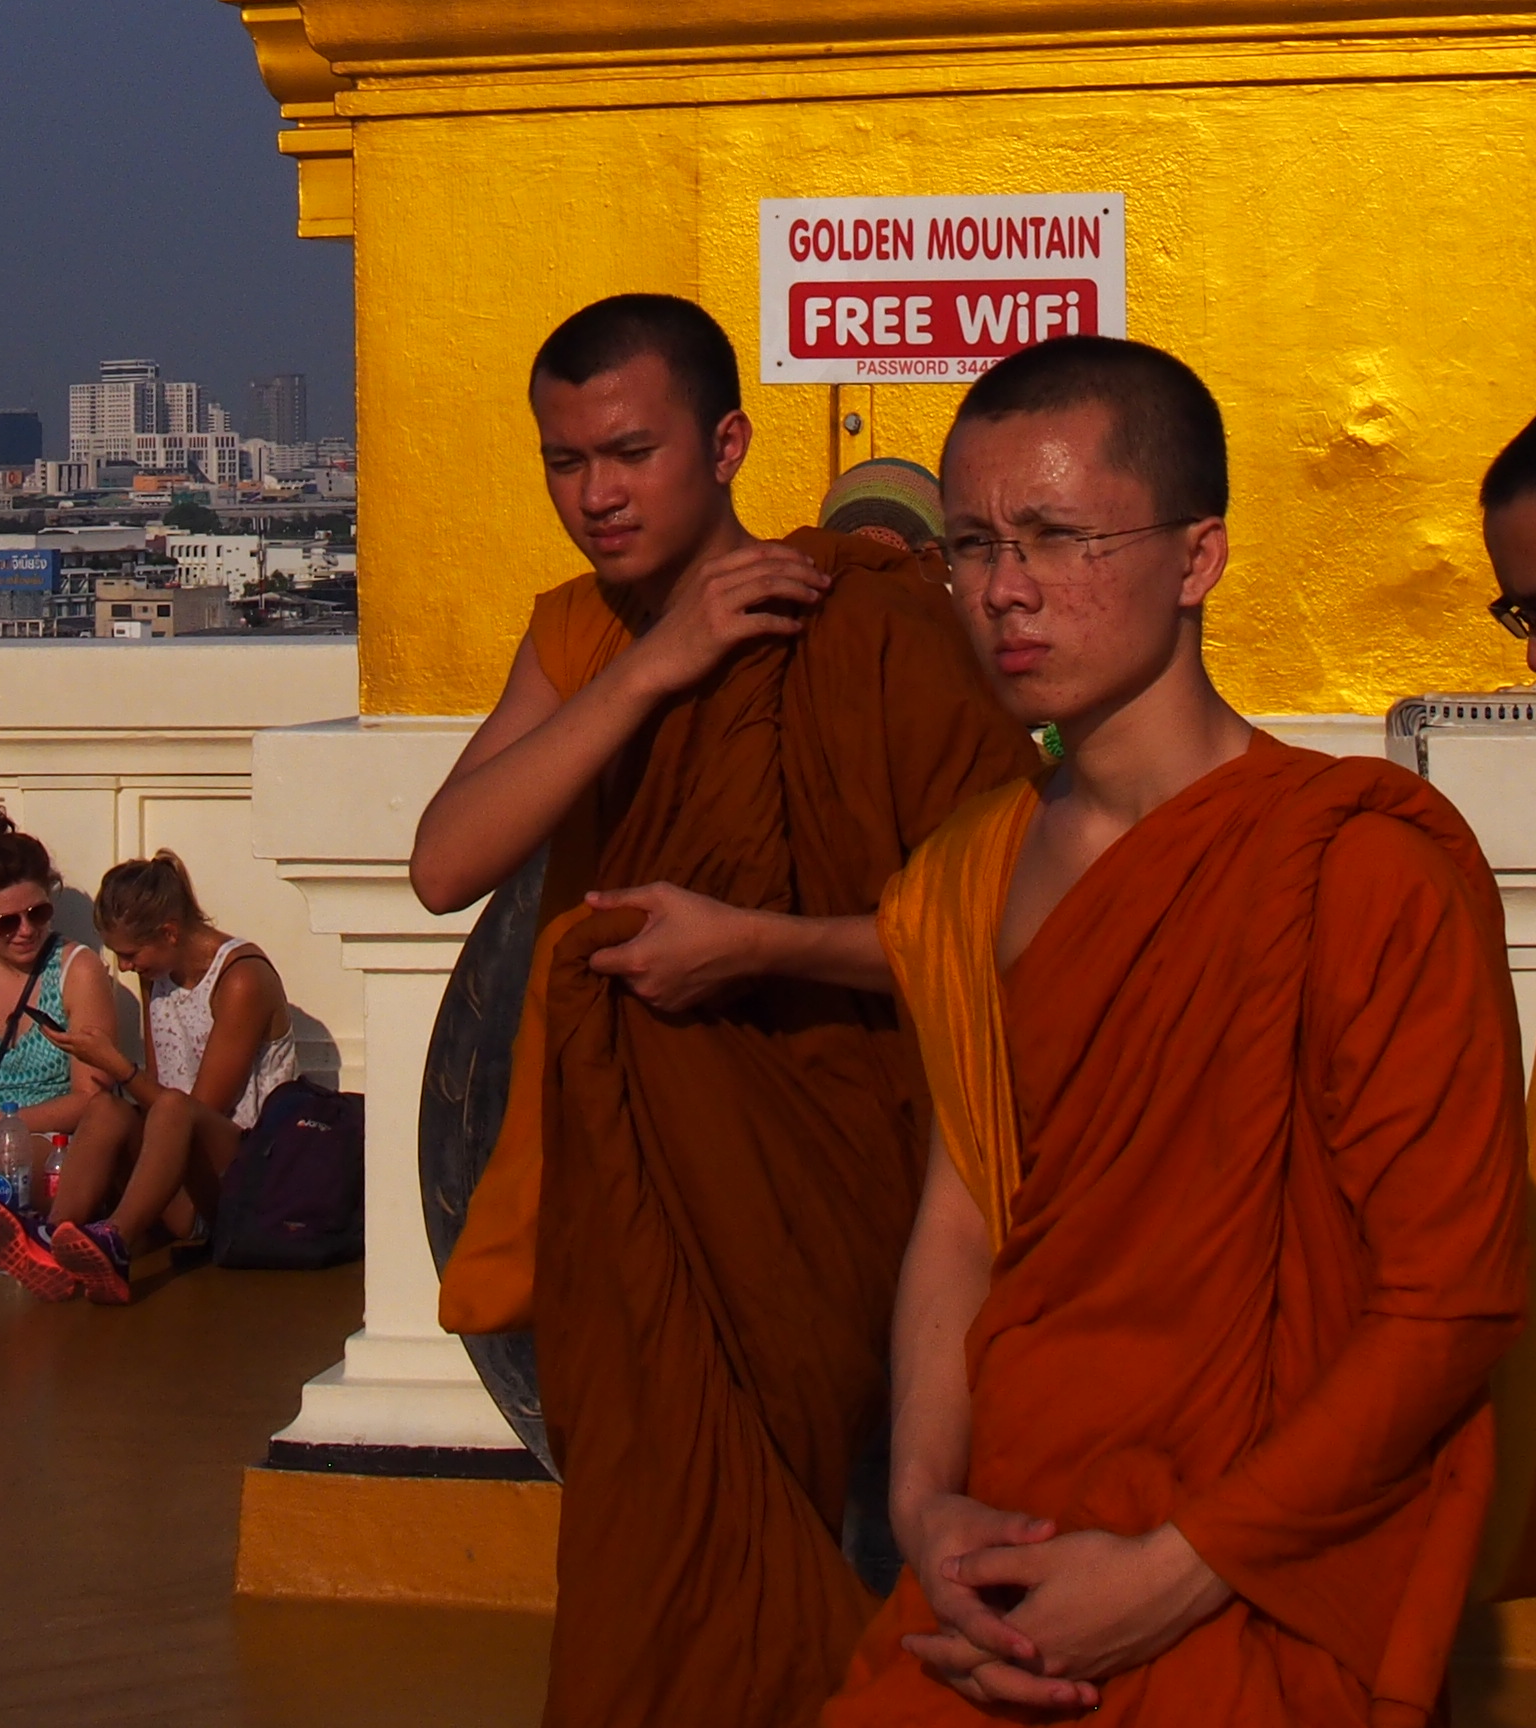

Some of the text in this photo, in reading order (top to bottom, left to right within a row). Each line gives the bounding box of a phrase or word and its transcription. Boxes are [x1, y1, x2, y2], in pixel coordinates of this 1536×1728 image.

[789, 215, 1100, 262] GOLDEN MOUNTAIN
[804, 291, 1080, 346] FREE WiFi
[857, 360, 949, 375] PASSWORD
